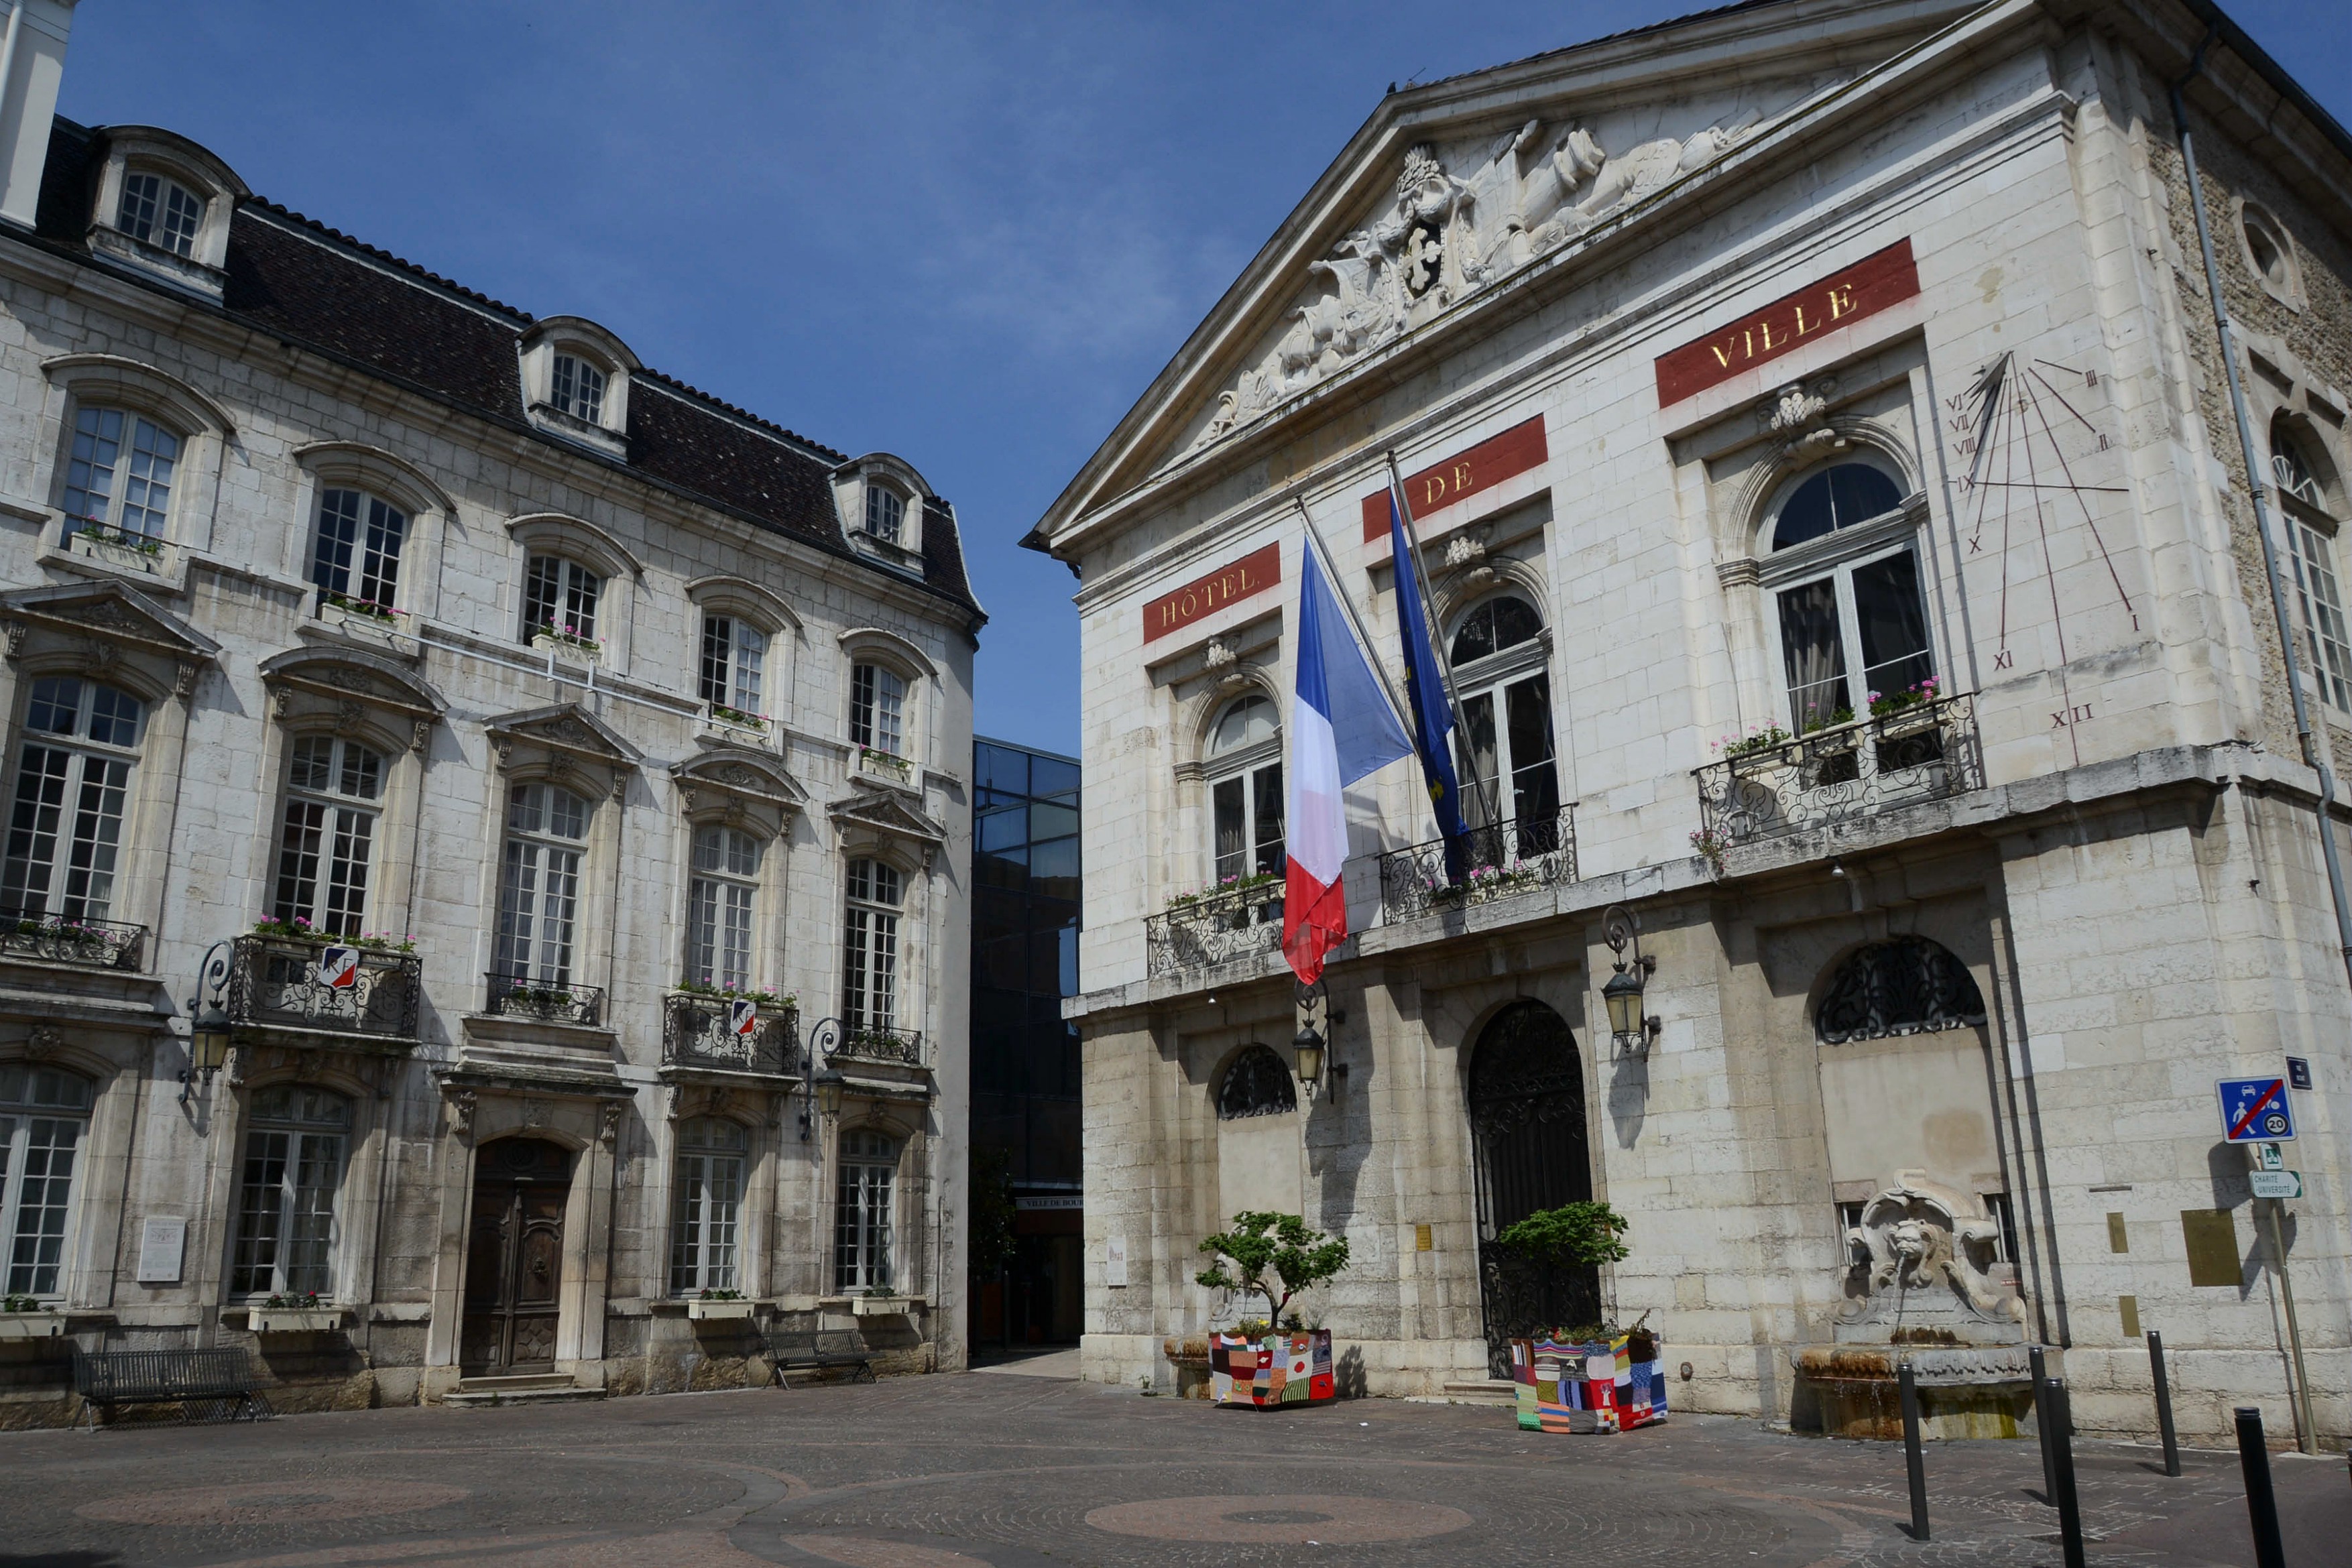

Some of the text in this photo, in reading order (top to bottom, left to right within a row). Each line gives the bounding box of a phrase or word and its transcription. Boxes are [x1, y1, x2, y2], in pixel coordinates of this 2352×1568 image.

[2085, 369, 2097, 387] III
[1425, 462, 1473, 505] DE
[1711, 284, 1857, 368] VILLE
[1946, 394, 1962, 412] VI
[1949, 414, 1969, 432] VII
[1952, 436, 1977, 456] VIII
[2099, 433, 2109, 451] II
[1958, 472, 1975, 493] IX
[1968, 534, 1983, 554] X
[2131, 614, 2140, 632] I
[1993, 650, 2013, 672] XI
[2049, 703, 2095, 729] XII
[327, 956, 354, 975] RF
[2269, 1120, 2284, 1128] 20
[2255, 1174, 2278, 1183] CHARITÉ
